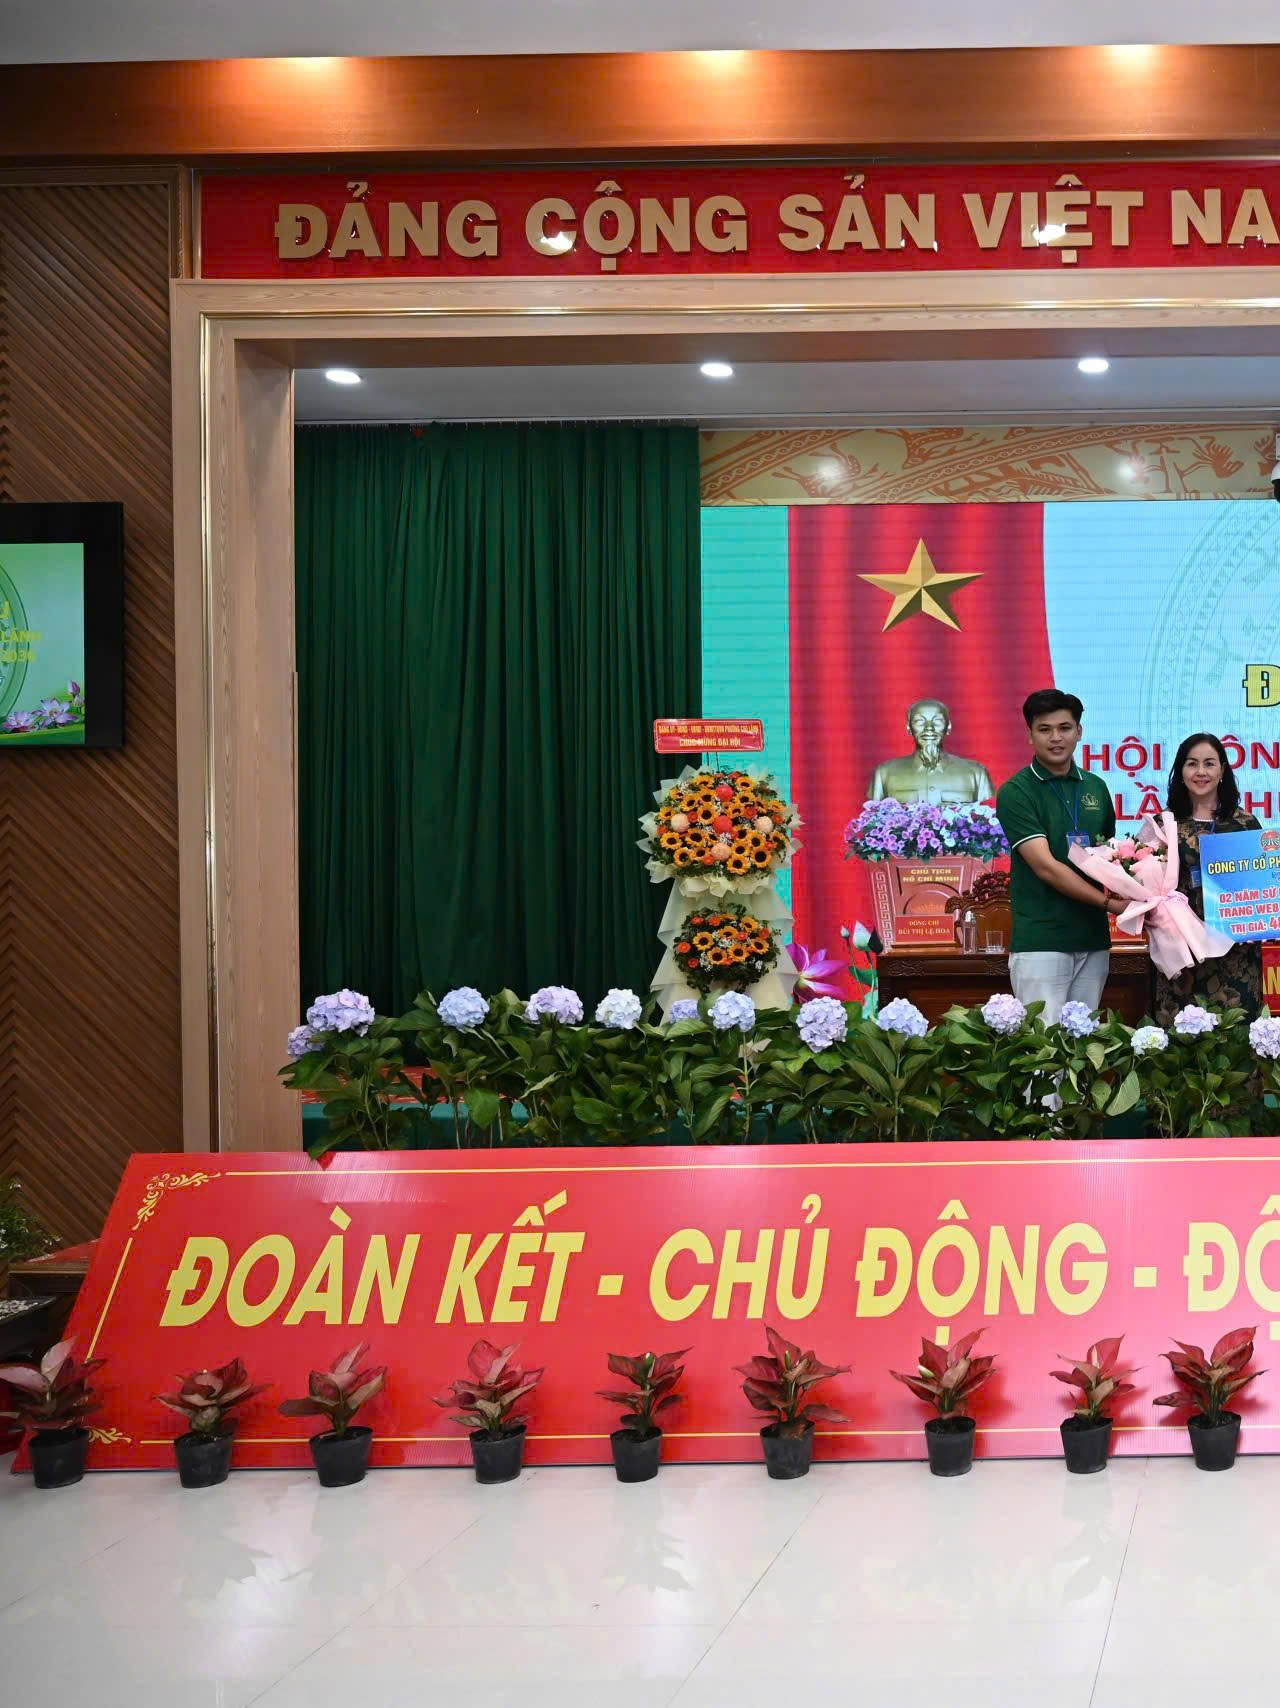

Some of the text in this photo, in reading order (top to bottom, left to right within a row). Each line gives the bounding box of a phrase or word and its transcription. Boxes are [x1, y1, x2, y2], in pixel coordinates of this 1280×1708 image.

[274, 181, 498, 258] ĐẢNG
[525, 180, 748, 271] CỘNG
[778, 174, 936, 253] SẢN
[962, 174, 1144, 264] VIỆT
[1082, 736, 1161, 777] HỘI
[1115, 782, 1162, 820] LẦ
[1208, 860, 1236, 875] CÔNG
[1238, 859, 1250, 872] TY
[1219, 893, 1232, 903] 02
[1235, 888, 1259, 902] NĂM
[1219, 906, 1253, 919] TRANG
[1256, 903, 1279, 914] WEB
[159, 1204, 421, 1327] ĐOÀN
[435, 1188, 585, 1324] KẾT
[597, 1273, 624, 1297] -
[649, 1192, 831, 1321] CHỦ
[854, 1199, 1108, 1346] ĐỘNG
[1132, 1266, 1157, 1288] -
